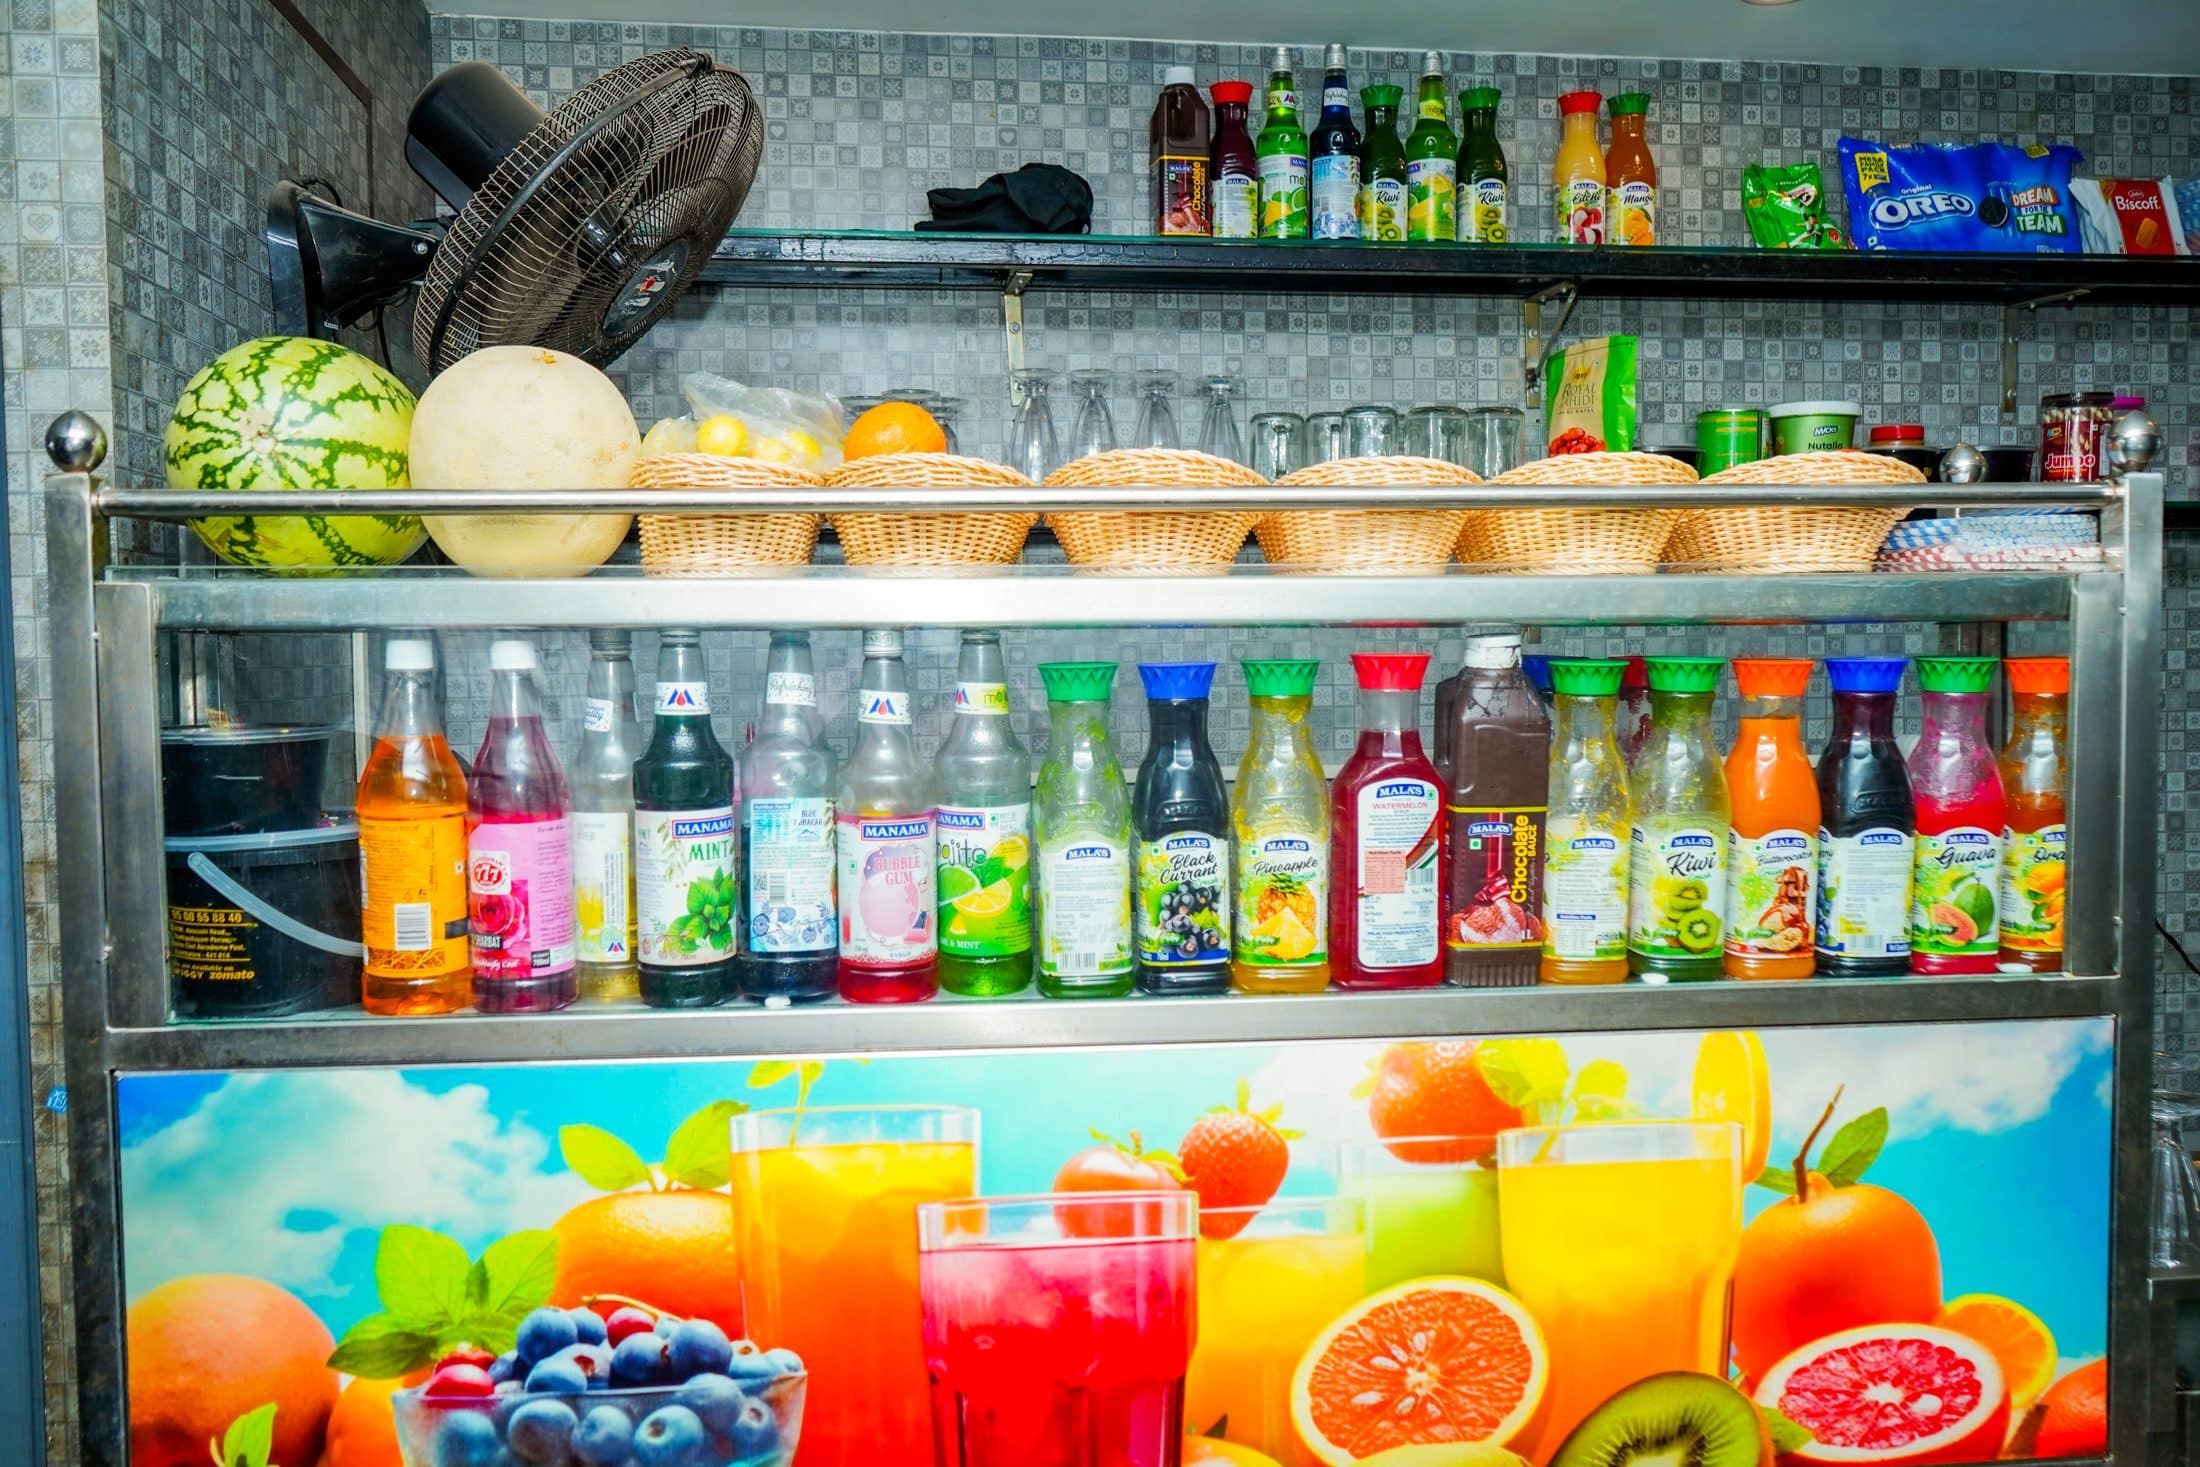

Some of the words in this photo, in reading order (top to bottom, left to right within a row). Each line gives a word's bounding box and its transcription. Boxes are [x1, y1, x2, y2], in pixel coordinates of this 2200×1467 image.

[1192, 161, 1201, 211] Chocolate
[1376, 191, 1400, 205] Kiwi
[1478, 192, 1504, 205] Kiwi
[1623, 194, 1653, 206] Mango
[2012, 187, 2054, 206] DREAM
[2115, 195, 2159, 210] Biscoff
[1875, 194, 1970, 223] OREO
[2016, 214, 2063, 233] TEAM
[1379, 785, 1423, 797] MALA'S
[1372, 802, 1428, 810] WATERMELON
[677, 818, 732, 835] MANAMA
[865, 823, 926, 837] MANAMA
[1471, 824, 1510, 833] MALA'S
[1168, 838, 1208, 849] MALA'S
[1266, 840, 1307, 850] MALA'S
[1528, 824, 1537, 857] SAUCE
[1574, 839, 1613, 849] MALA'S
[1673, 837, 1712, 847] MALA'S
[1768, 838, 1806, 848] MALA'S
[1947, 835, 1988, 843] MALA'S
[688, 840, 729, 862] MINT
[1068, 848, 1109, 859] MALA'S
[1935, 847, 1996, 869] Guava
[875, 855, 921, 872] BUBBLE
[1170, 851, 1216, 871] Black
[1253, 857, 1318, 875] Pineapple
[1510, 815, 1529, 903] Chocolate
[1666, 851, 1717, 877] Kiwi
[475, 864, 499, 880] 777
[885, 871, 913, 886] GUM
[1160, 864, 1218, 884] Currant
[228, 912, 242, 922] 40
[957, 940, 980, 950] MINT
[209, 969, 255, 979] zomato
